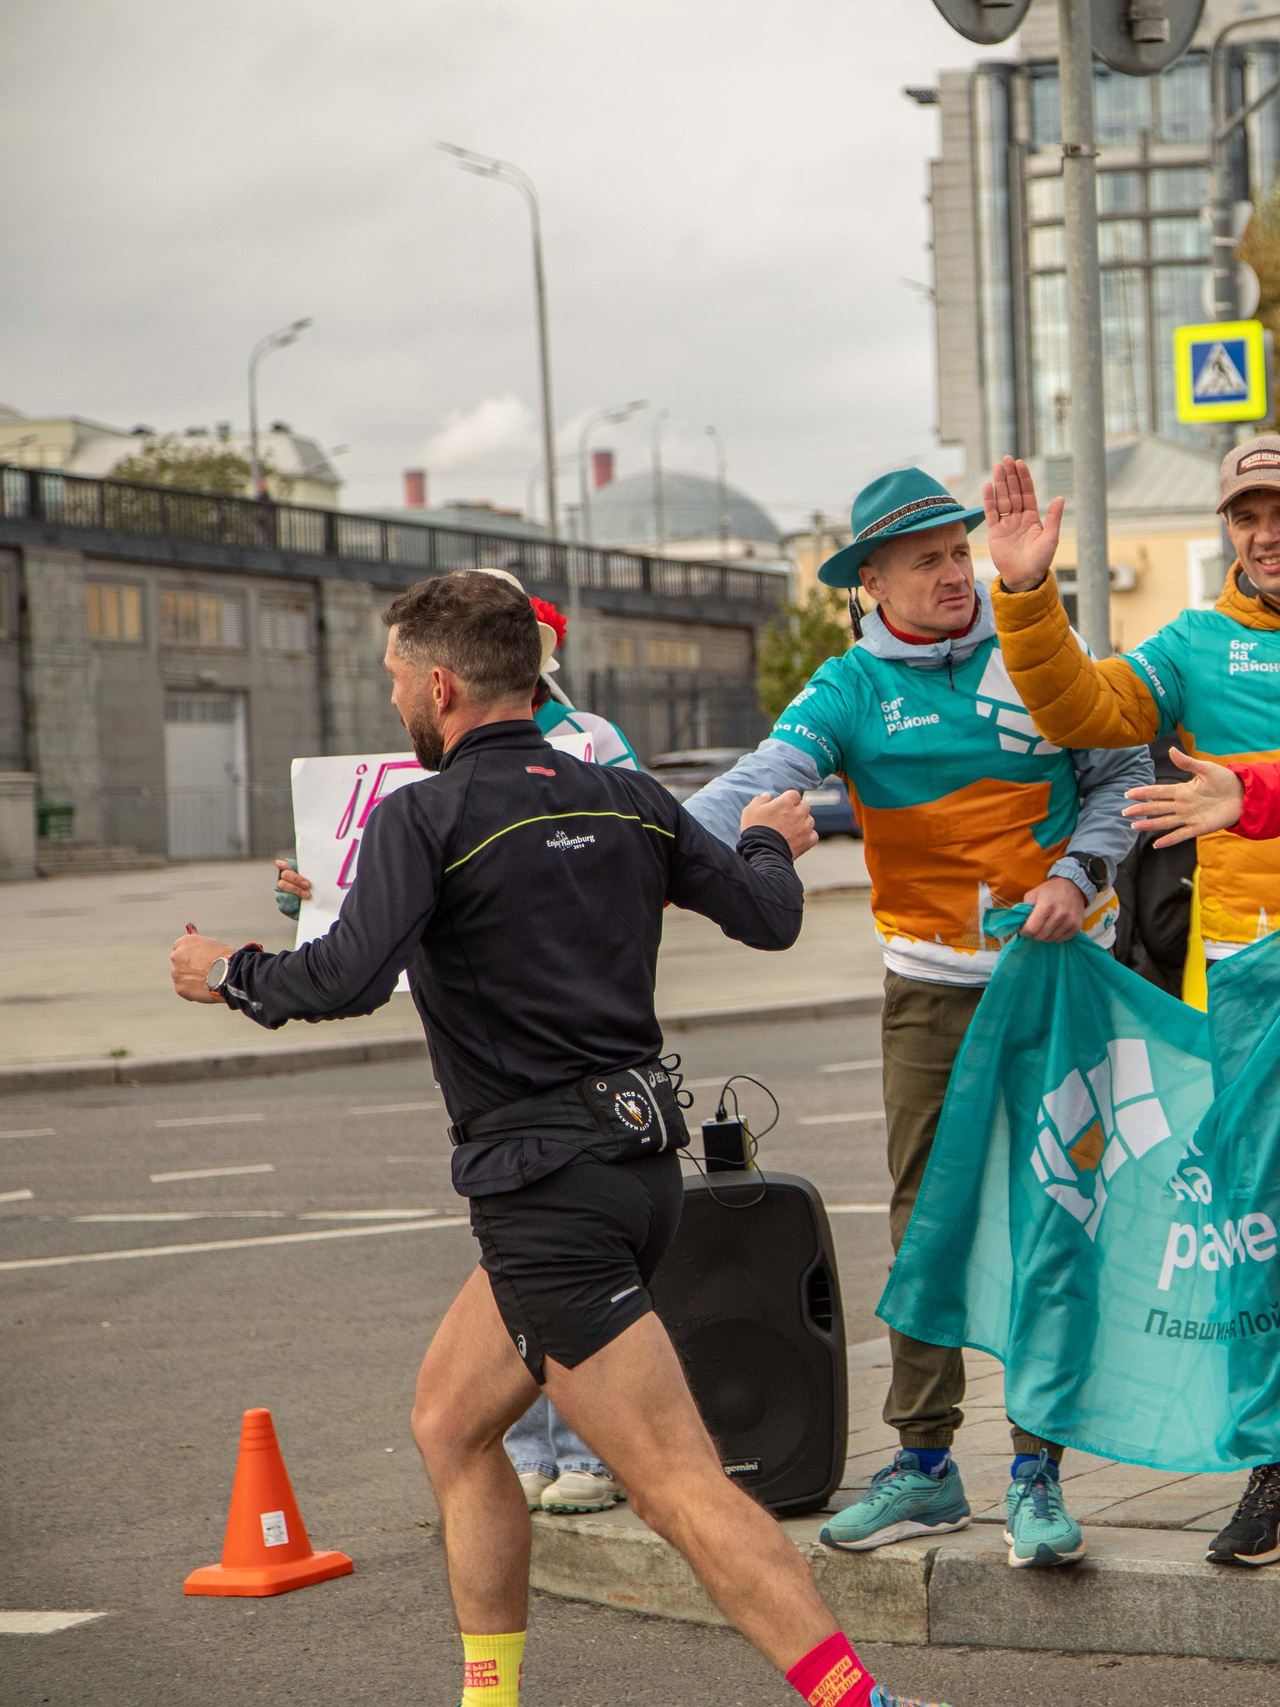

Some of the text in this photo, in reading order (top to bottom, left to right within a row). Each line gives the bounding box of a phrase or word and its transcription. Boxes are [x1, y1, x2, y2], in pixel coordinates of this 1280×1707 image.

[1229, 640, 1258, 651] бег
[1229, 651, 1249, 661] на
[880, 697, 905, 714] бег
[883, 708, 902, 722] на
[887, 713, 940, 736] районе
[560, 835, 596, 847] Hamburg
[614, 1103, 639, 1131] MARATHON
[724, 1461, 759, 1475] gemini
